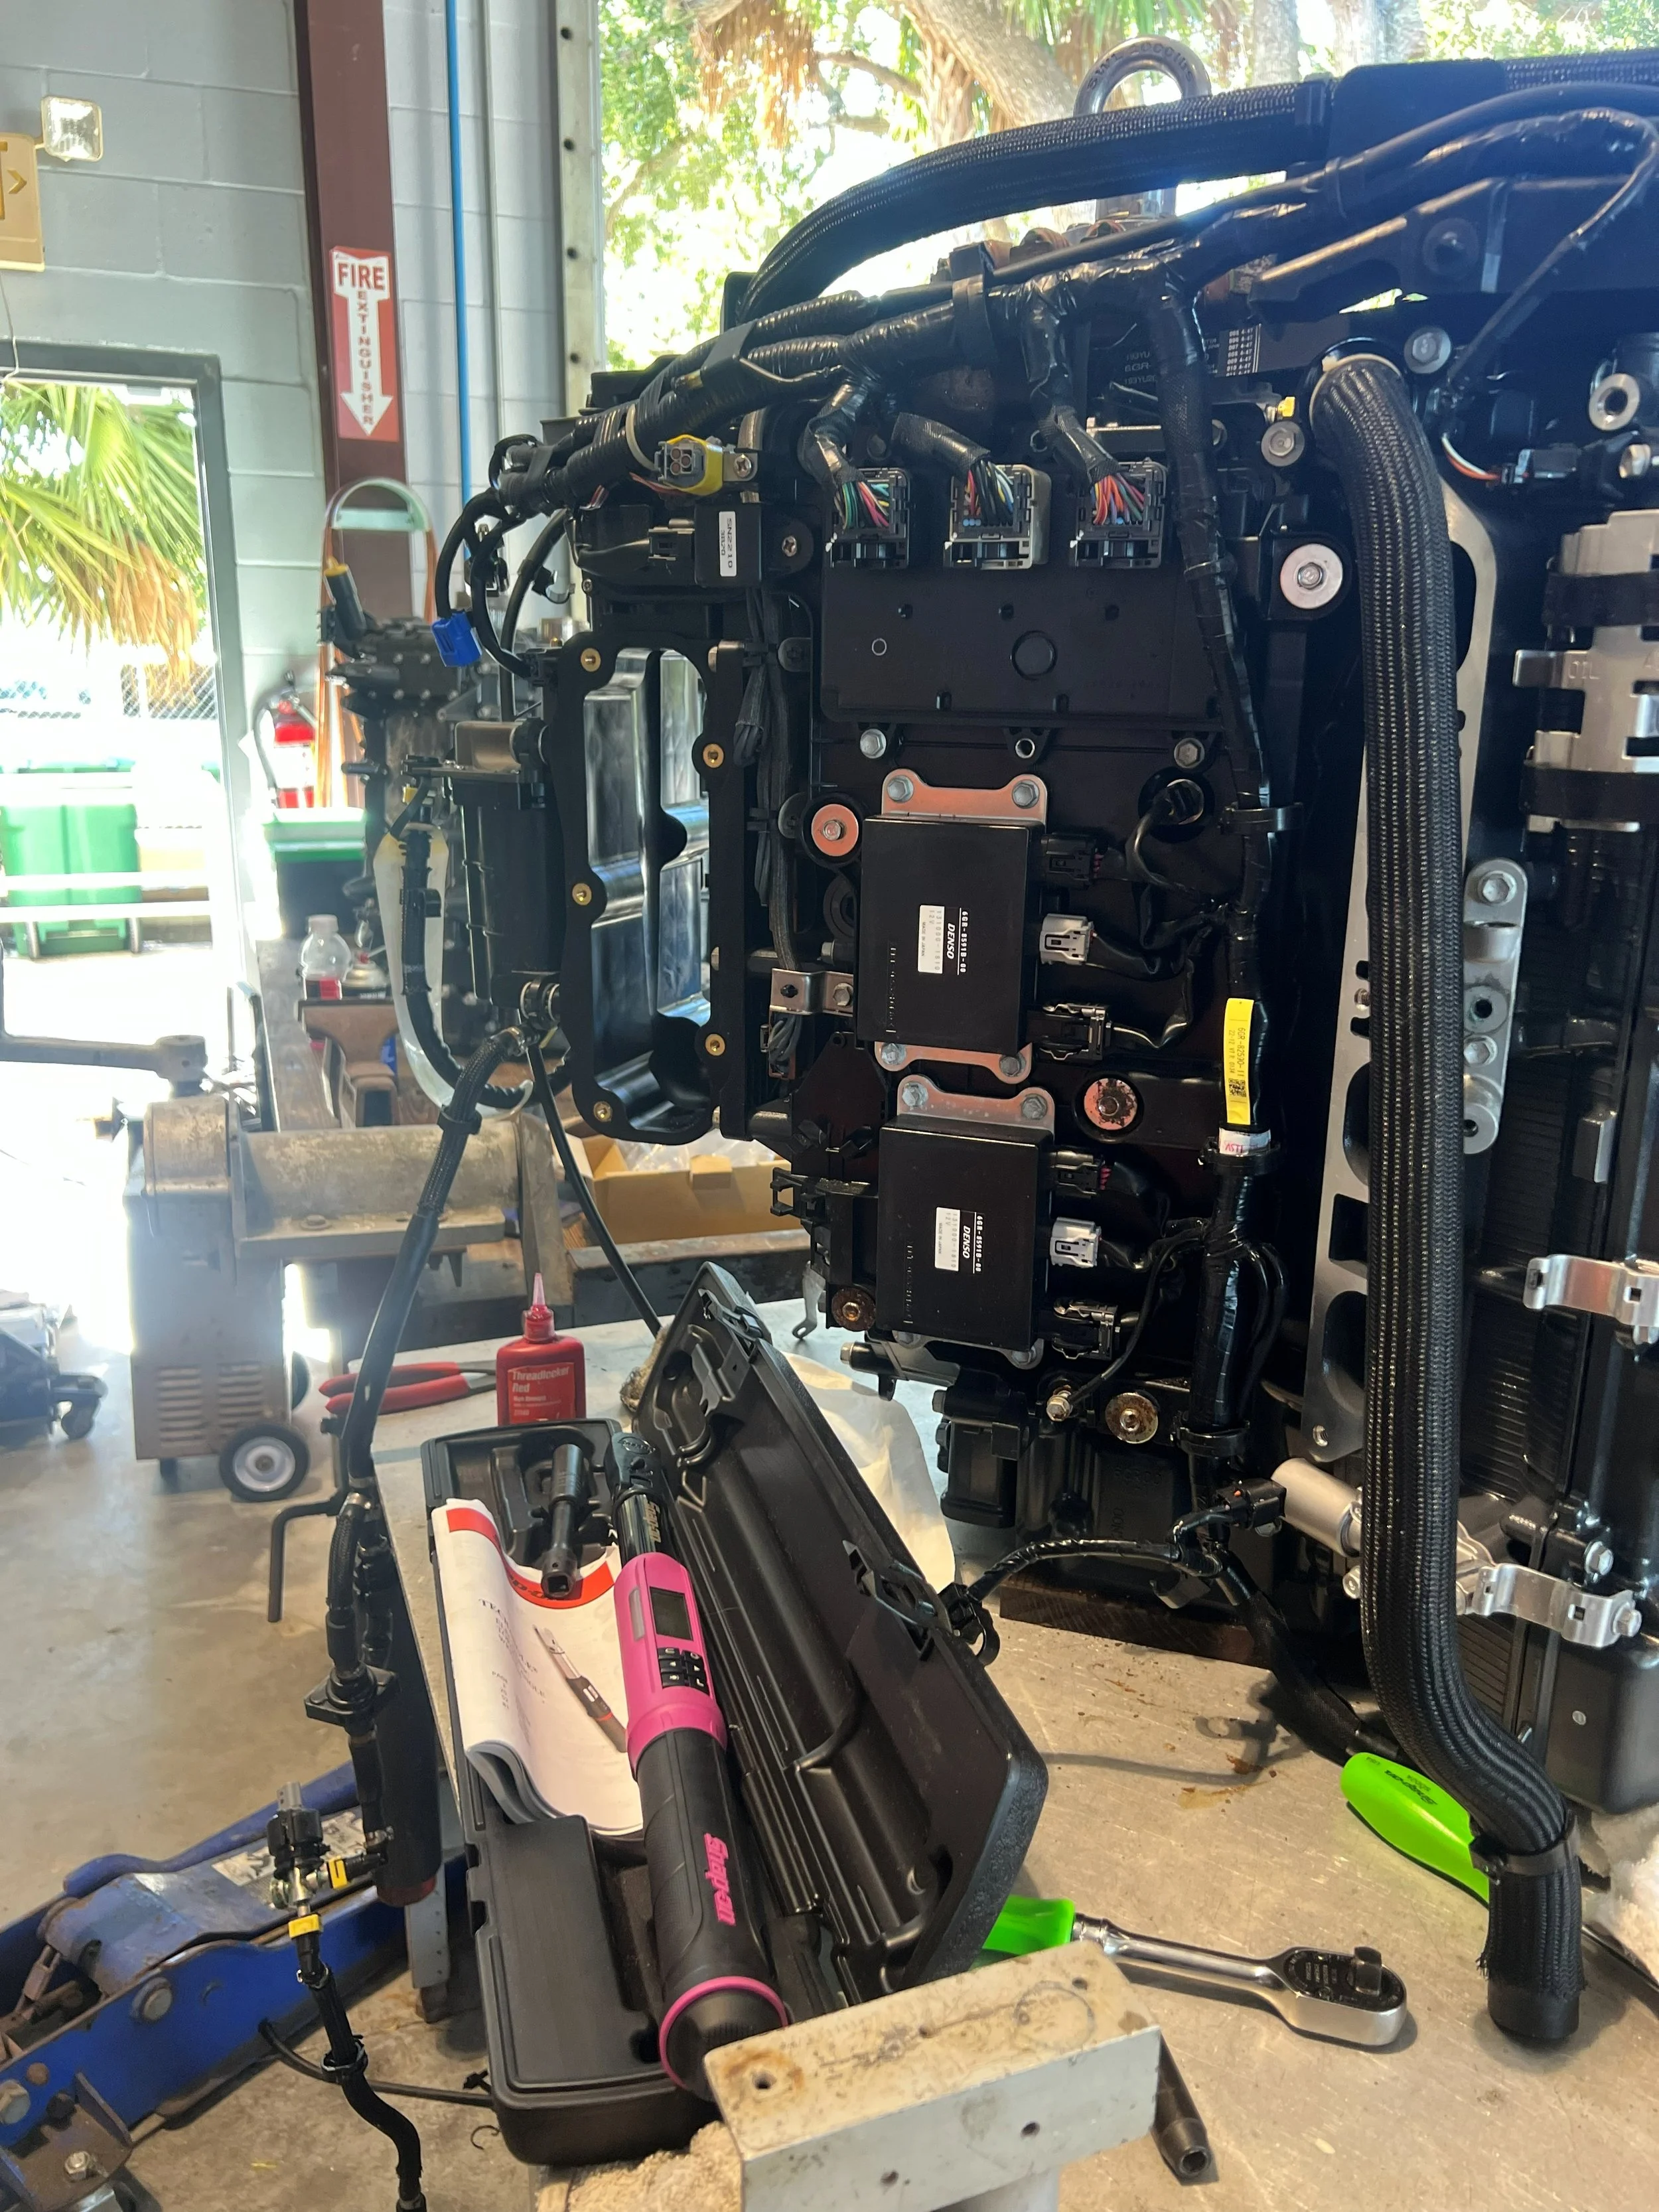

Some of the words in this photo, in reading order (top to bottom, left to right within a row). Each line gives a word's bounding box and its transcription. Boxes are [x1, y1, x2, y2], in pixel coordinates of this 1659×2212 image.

[338, 263, 385, 291] FIRE
[358, 291, 374, 426] EXTINGUISHER
[946, 922, 956, 960] DENSO
[1236, 1027, 1246, 1077] 6GR-82590-11
[962, 1225, 971, 1259] DENSO
[512, 1366, 569, 1381] Threadlocker
[512, 1382, 530, 1393] Red
[704, 1832, 736, 1926] Snap-on
